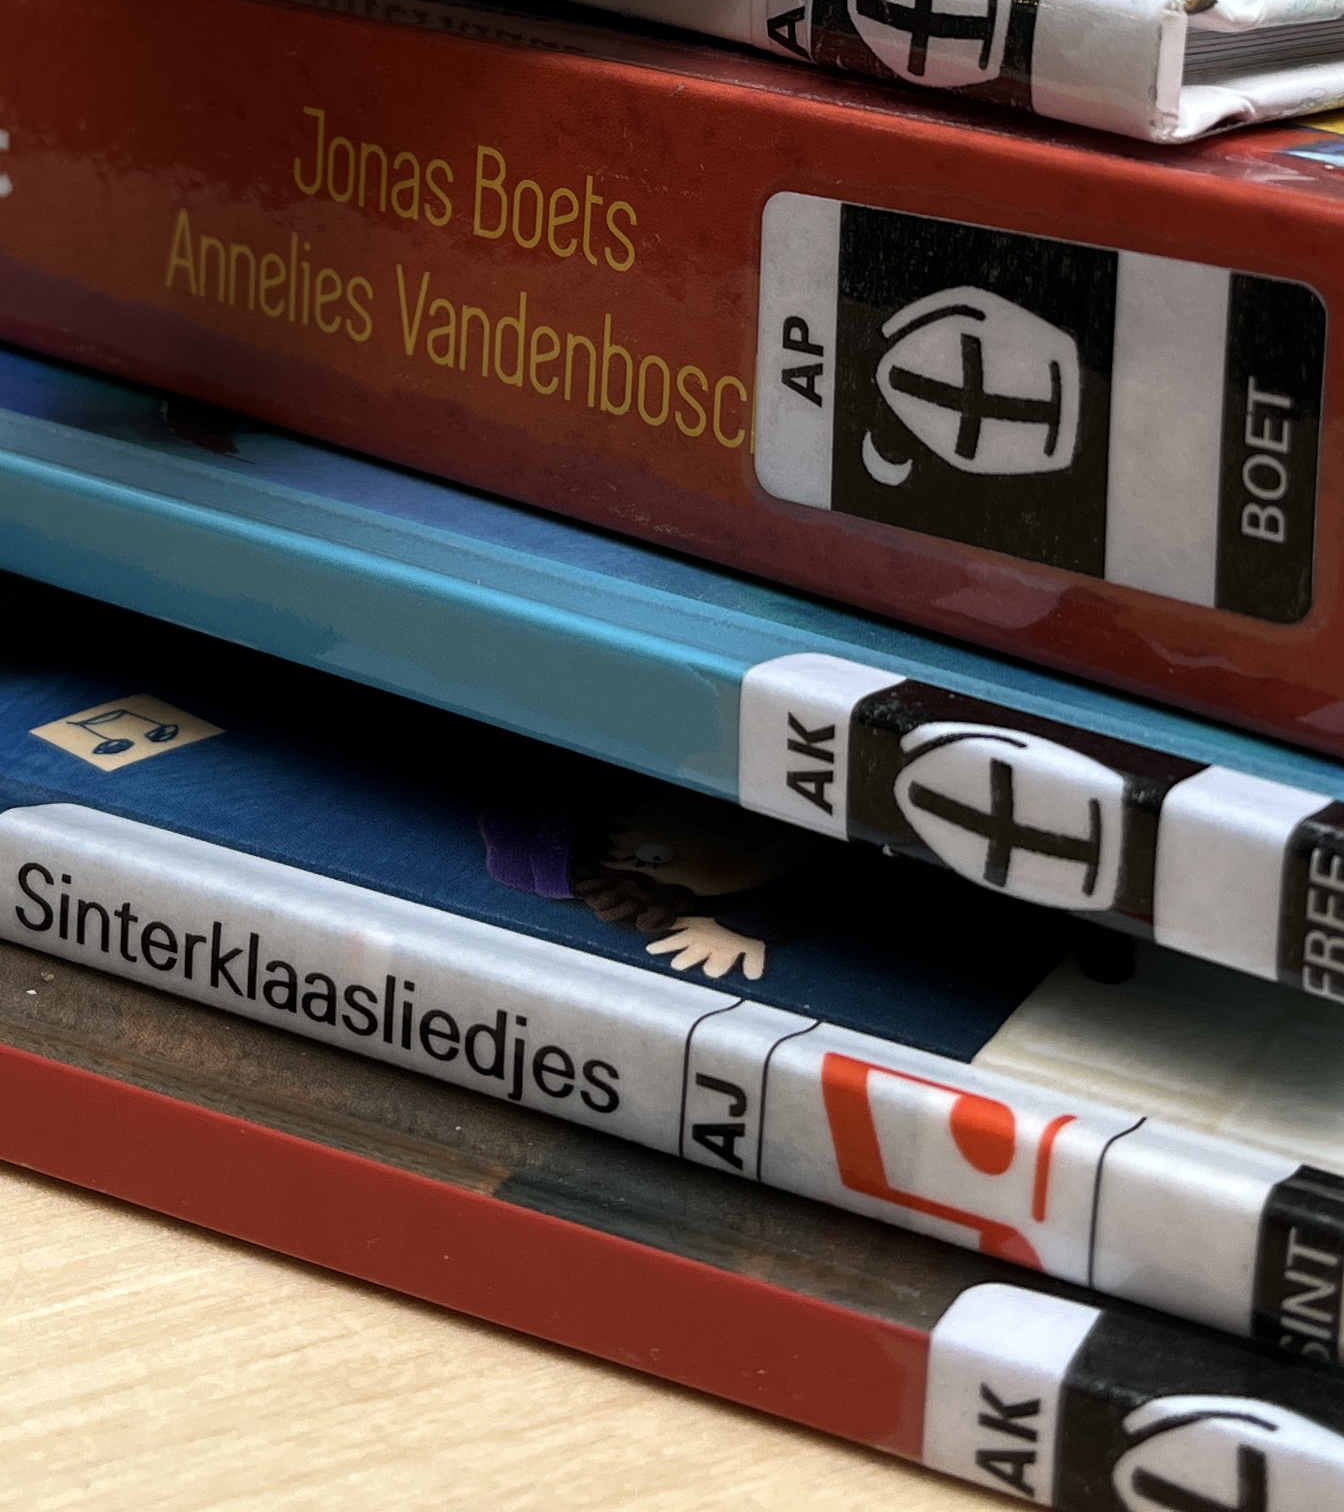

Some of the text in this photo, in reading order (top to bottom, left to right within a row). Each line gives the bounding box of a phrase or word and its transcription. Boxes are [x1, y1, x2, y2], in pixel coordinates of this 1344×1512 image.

[293, 105, 638, 273] Jonas Boets
[165, 206, 755, 455] Annelies Vandenbosc
[781, 315, 824, 407] AP
[1241, 376, 1293, 544] BOET
[787, 712, 836, 815] AK
[15, 861, 621, 1115] Sinterklaasliedjes
[691, 1073, 748, 1171] AJ
[974, 1382, 1042, 1499] AK
